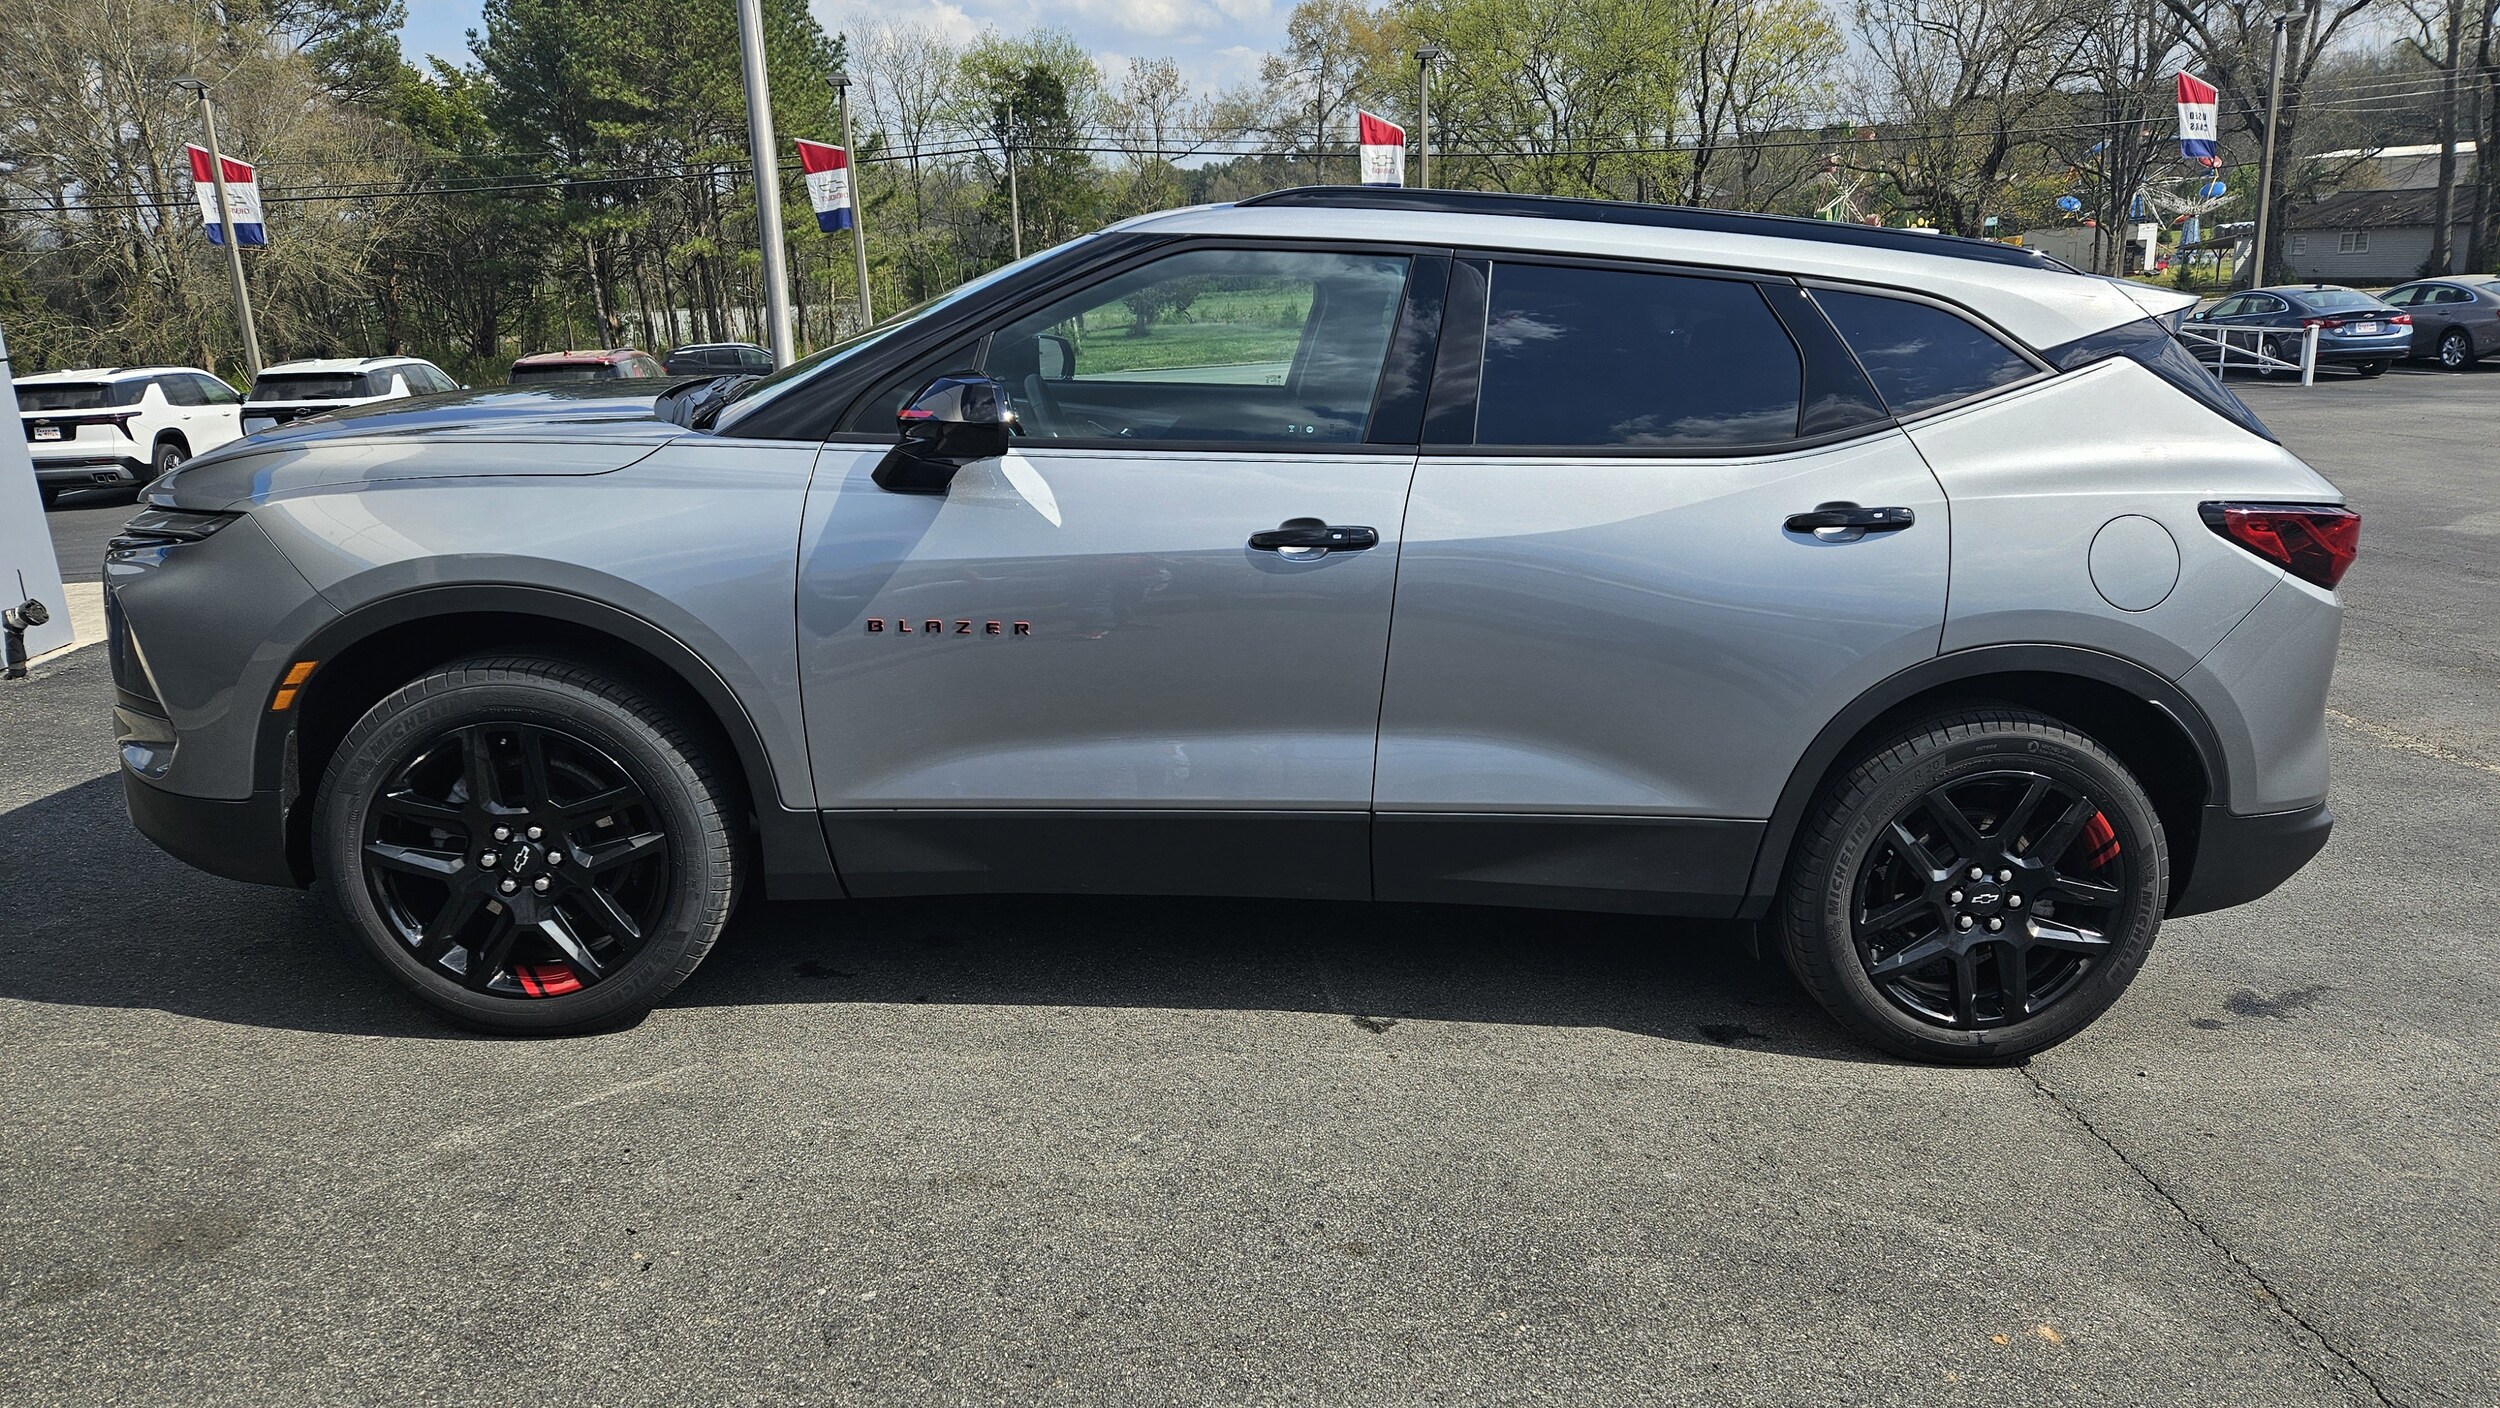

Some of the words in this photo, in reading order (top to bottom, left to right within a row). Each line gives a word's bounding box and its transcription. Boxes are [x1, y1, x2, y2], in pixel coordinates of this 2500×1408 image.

[866, 618, 1031, 636] BLAZER
[1827, 820, 1871, 917] MICHELIN
[2108, 890, 2153, 982] MICHELIN
